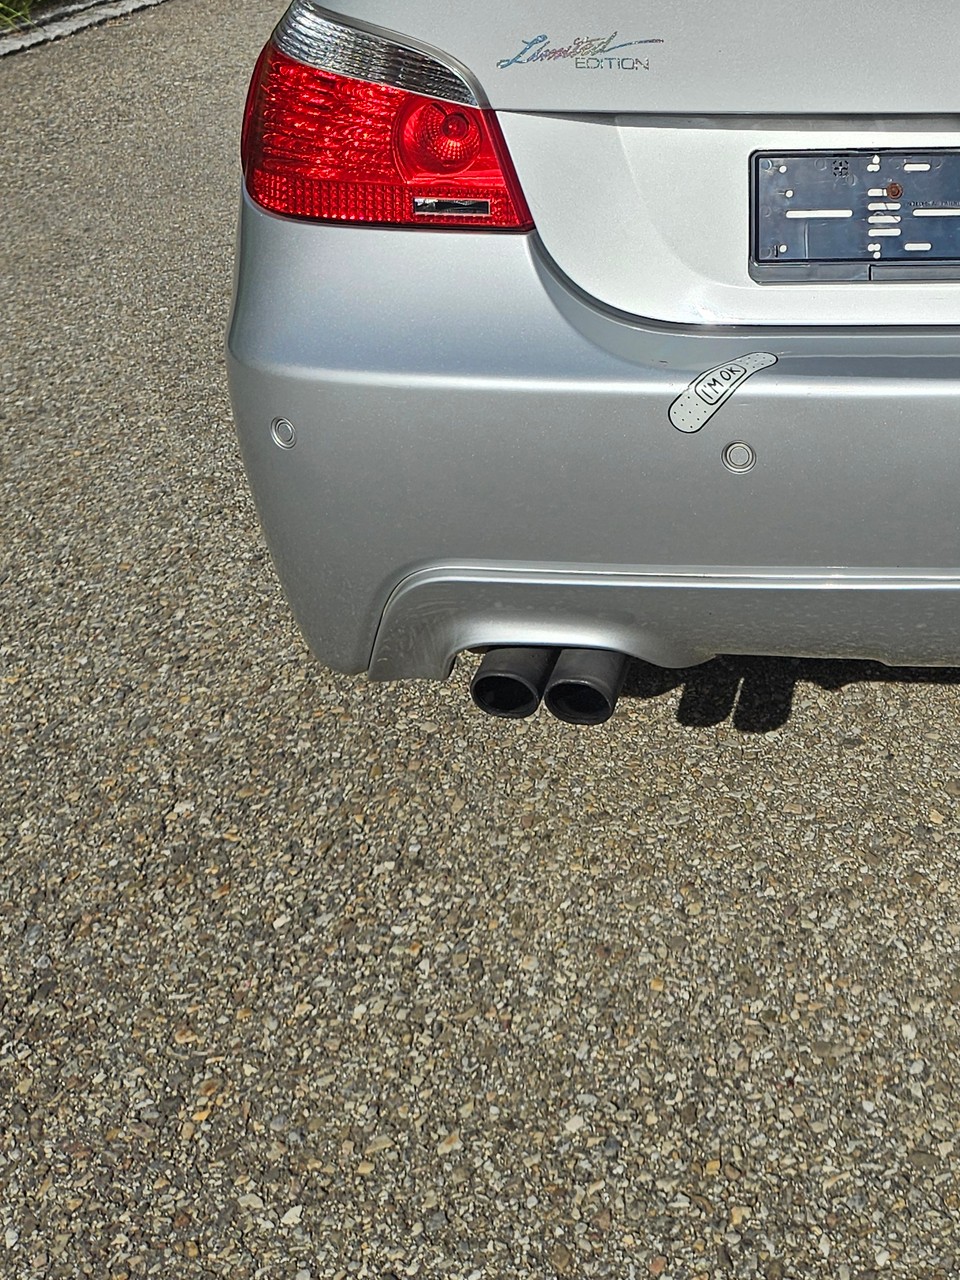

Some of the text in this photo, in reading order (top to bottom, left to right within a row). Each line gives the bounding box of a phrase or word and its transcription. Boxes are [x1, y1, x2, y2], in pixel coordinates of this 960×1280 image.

[497, 31, 663, 69] Limited
[575, 56, 650, 70] EDITION
[701, 366, 741, 400] I'M OK
